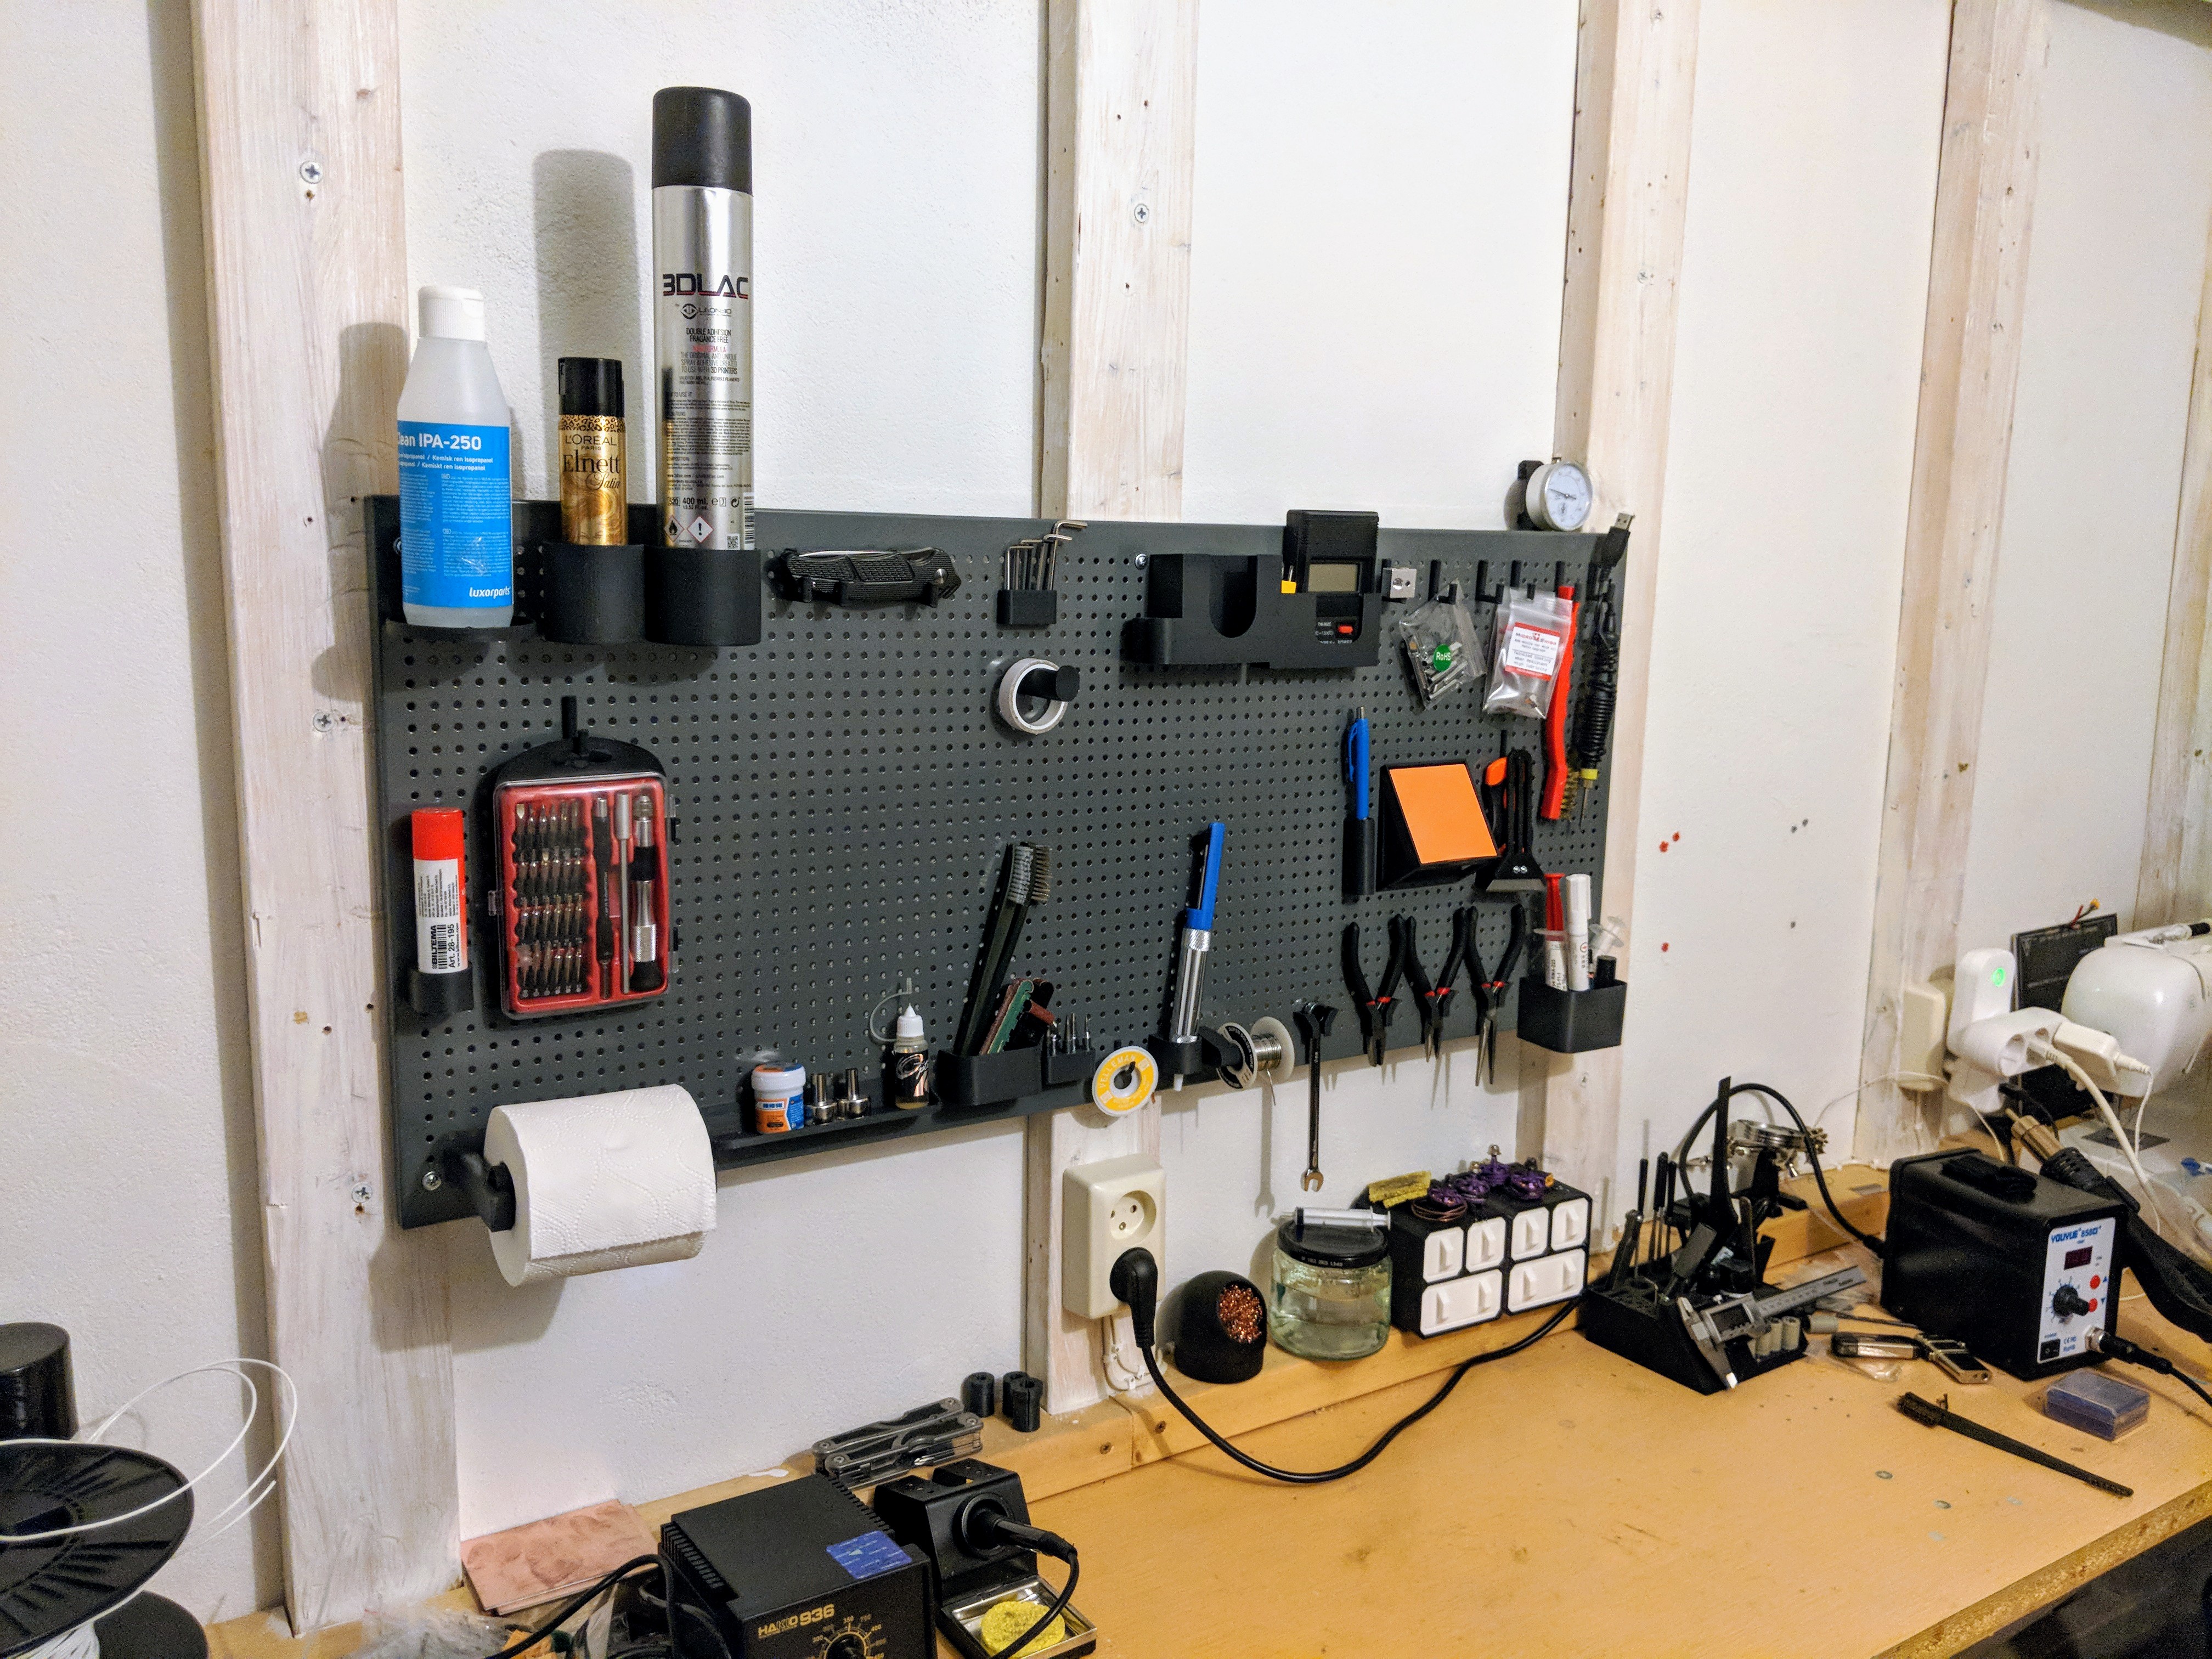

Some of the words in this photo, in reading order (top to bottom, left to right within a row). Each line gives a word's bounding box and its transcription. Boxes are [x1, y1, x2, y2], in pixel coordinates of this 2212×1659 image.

[663, 274, 748, 300] 3DLAC
[398, 432, 416, 447] lean
[419, 433, 482, 450] IPA-250
[563, 449, 620, 474] Elnett
[585, 471, 620, 490] Satin
[469, 586, 510, 599] luxorparts
[1436, 652, 1451, 661] RoHS
[1099, 1054, 1136, 1088] VELLEMAN
[2051, 1230, 2078, 1244] YOUYUE
[800, 1604, 835, 1626] 936
